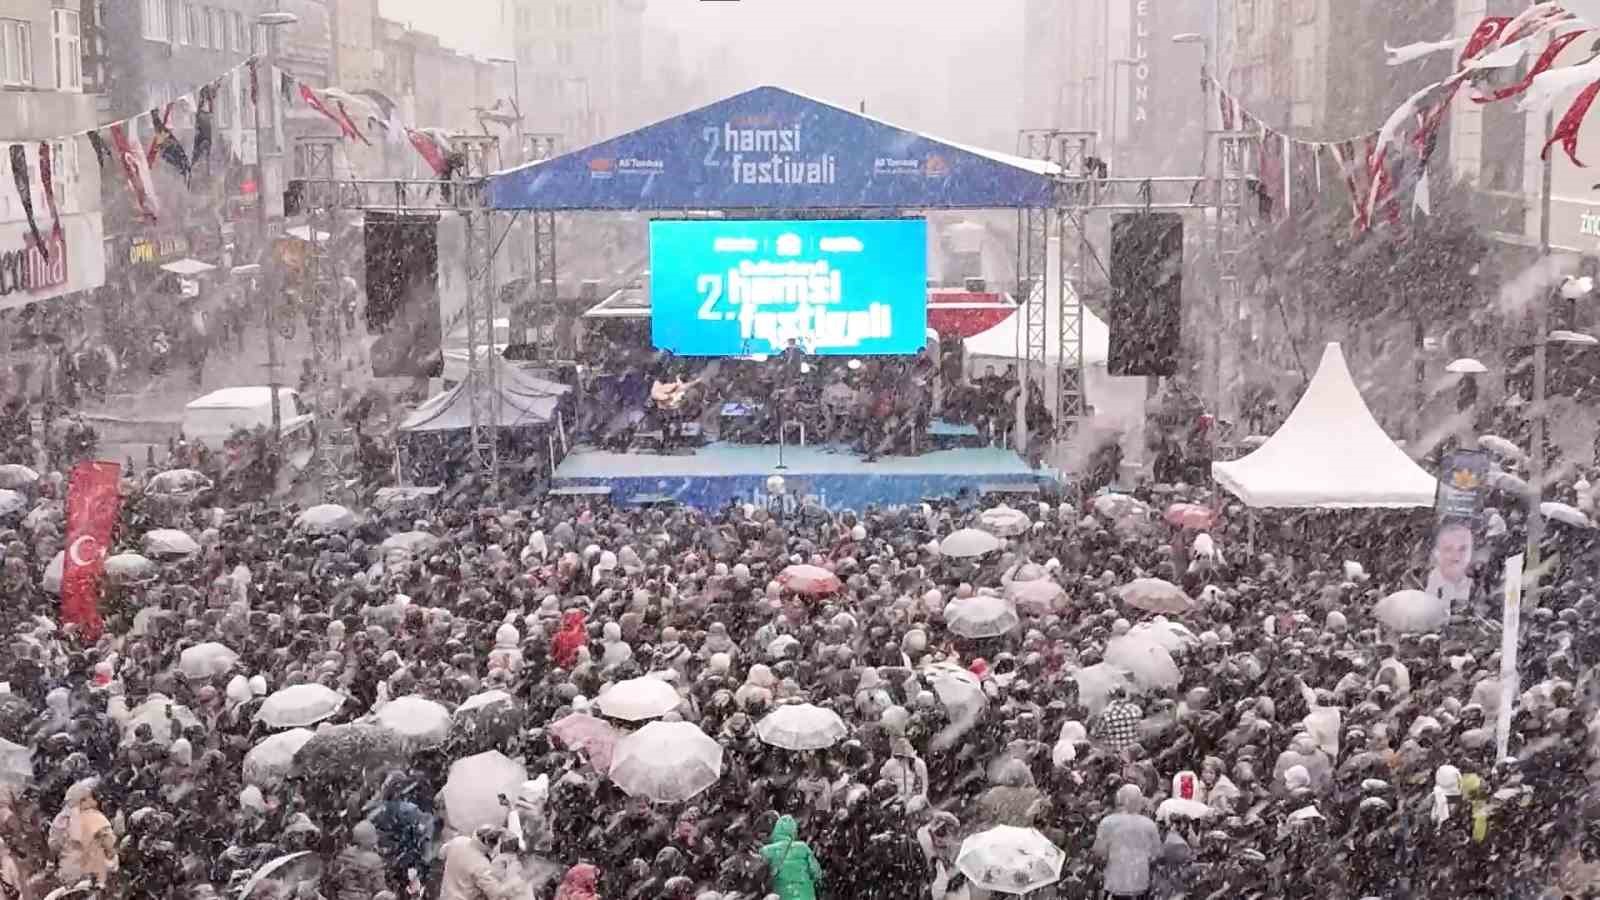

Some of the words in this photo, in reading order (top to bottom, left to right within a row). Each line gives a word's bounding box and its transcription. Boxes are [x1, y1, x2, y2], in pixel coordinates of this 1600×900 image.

[724, 121, 801, 152] hamsi
[732, 153, 835, 184] festivali
[727, 268, 842, 304] hamsi
[738, 301, 893, 340] festivali
